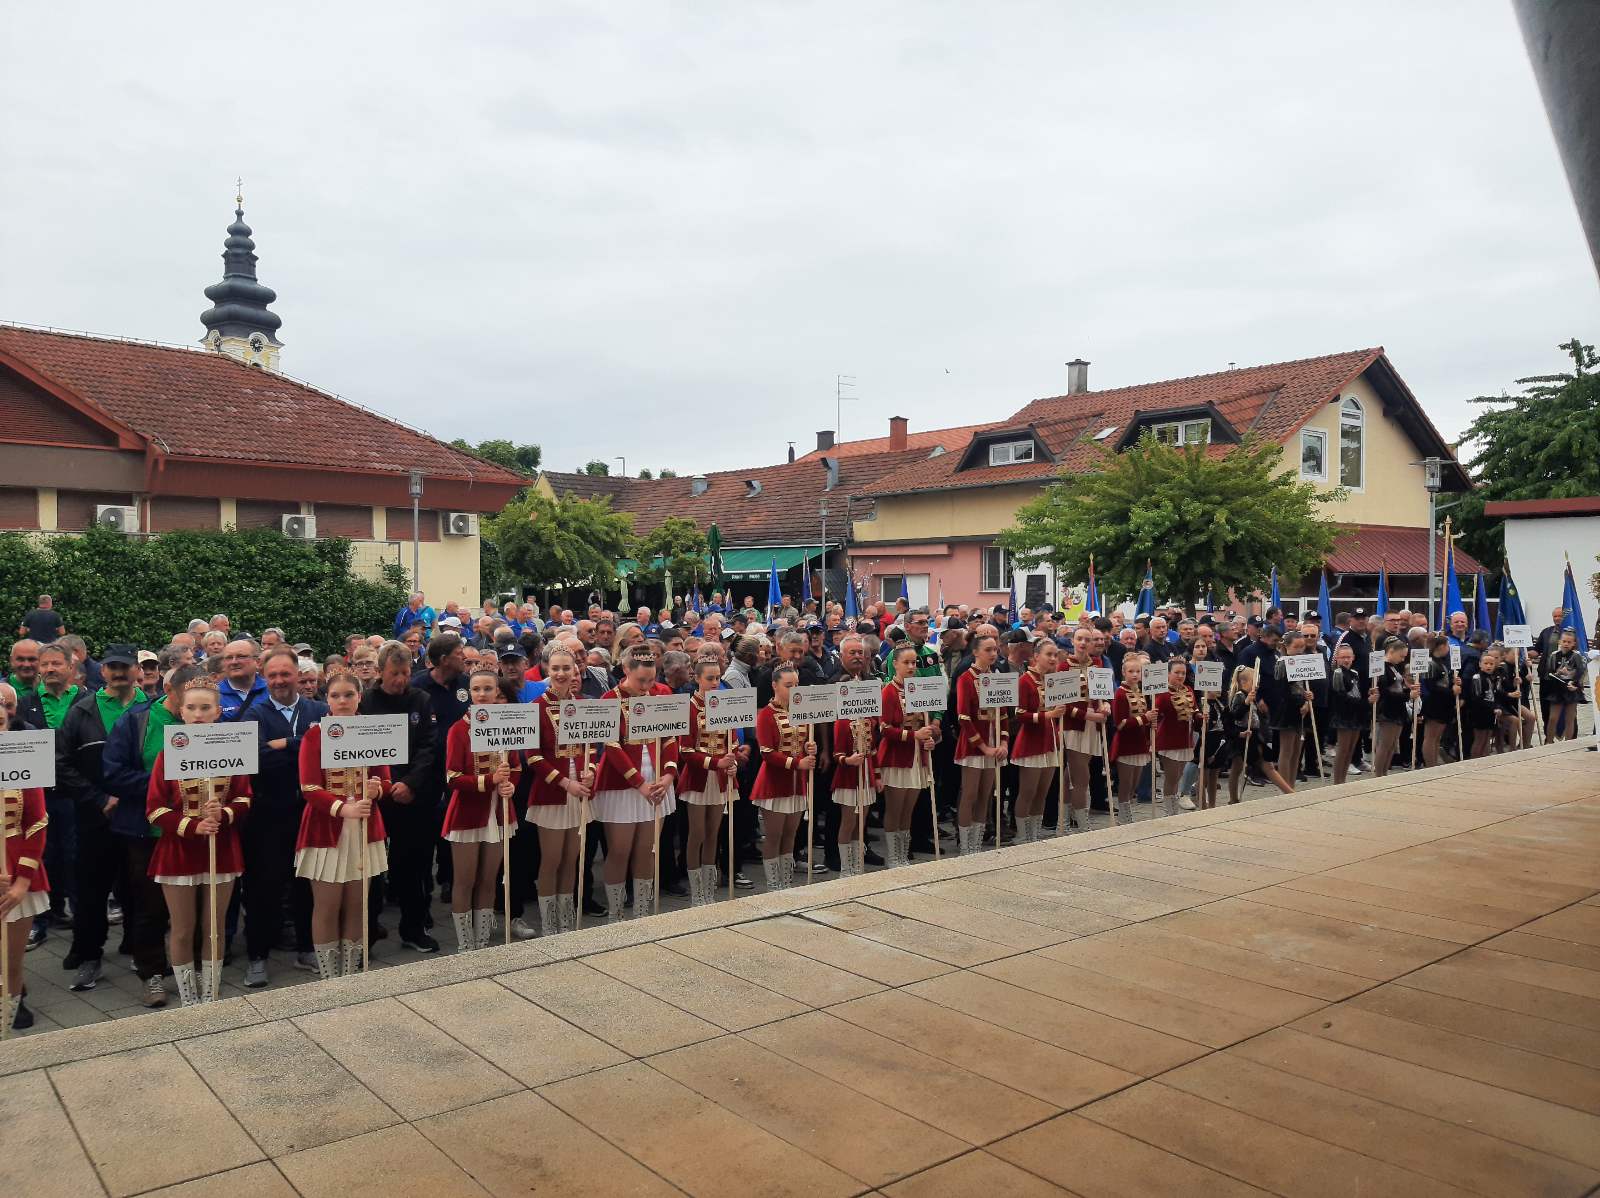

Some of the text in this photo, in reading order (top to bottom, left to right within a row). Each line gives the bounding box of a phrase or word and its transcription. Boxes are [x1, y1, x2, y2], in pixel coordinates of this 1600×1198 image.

[843, 698, 877, 707] PODTUREN
[792, 710, 834, 721] PRIBISLAVEC
[840, 706, 879, 716] DEKANOVEC
[563, 720, 616, 730] SVETI JURAJ
[709, 714, 754, 726] SAVSKA VES
[474, 726, 536, 737] SVETI MARTIN
[631, 721, 687, 734] STRAHONINEC
[582, 730, 611, 739] BREGU
[487, 736, 525, 747] NA MURI
[333, 748, 397, 761] ŠENKOVEC
[180, 757, 244, 771] ŠTRIGOVA
